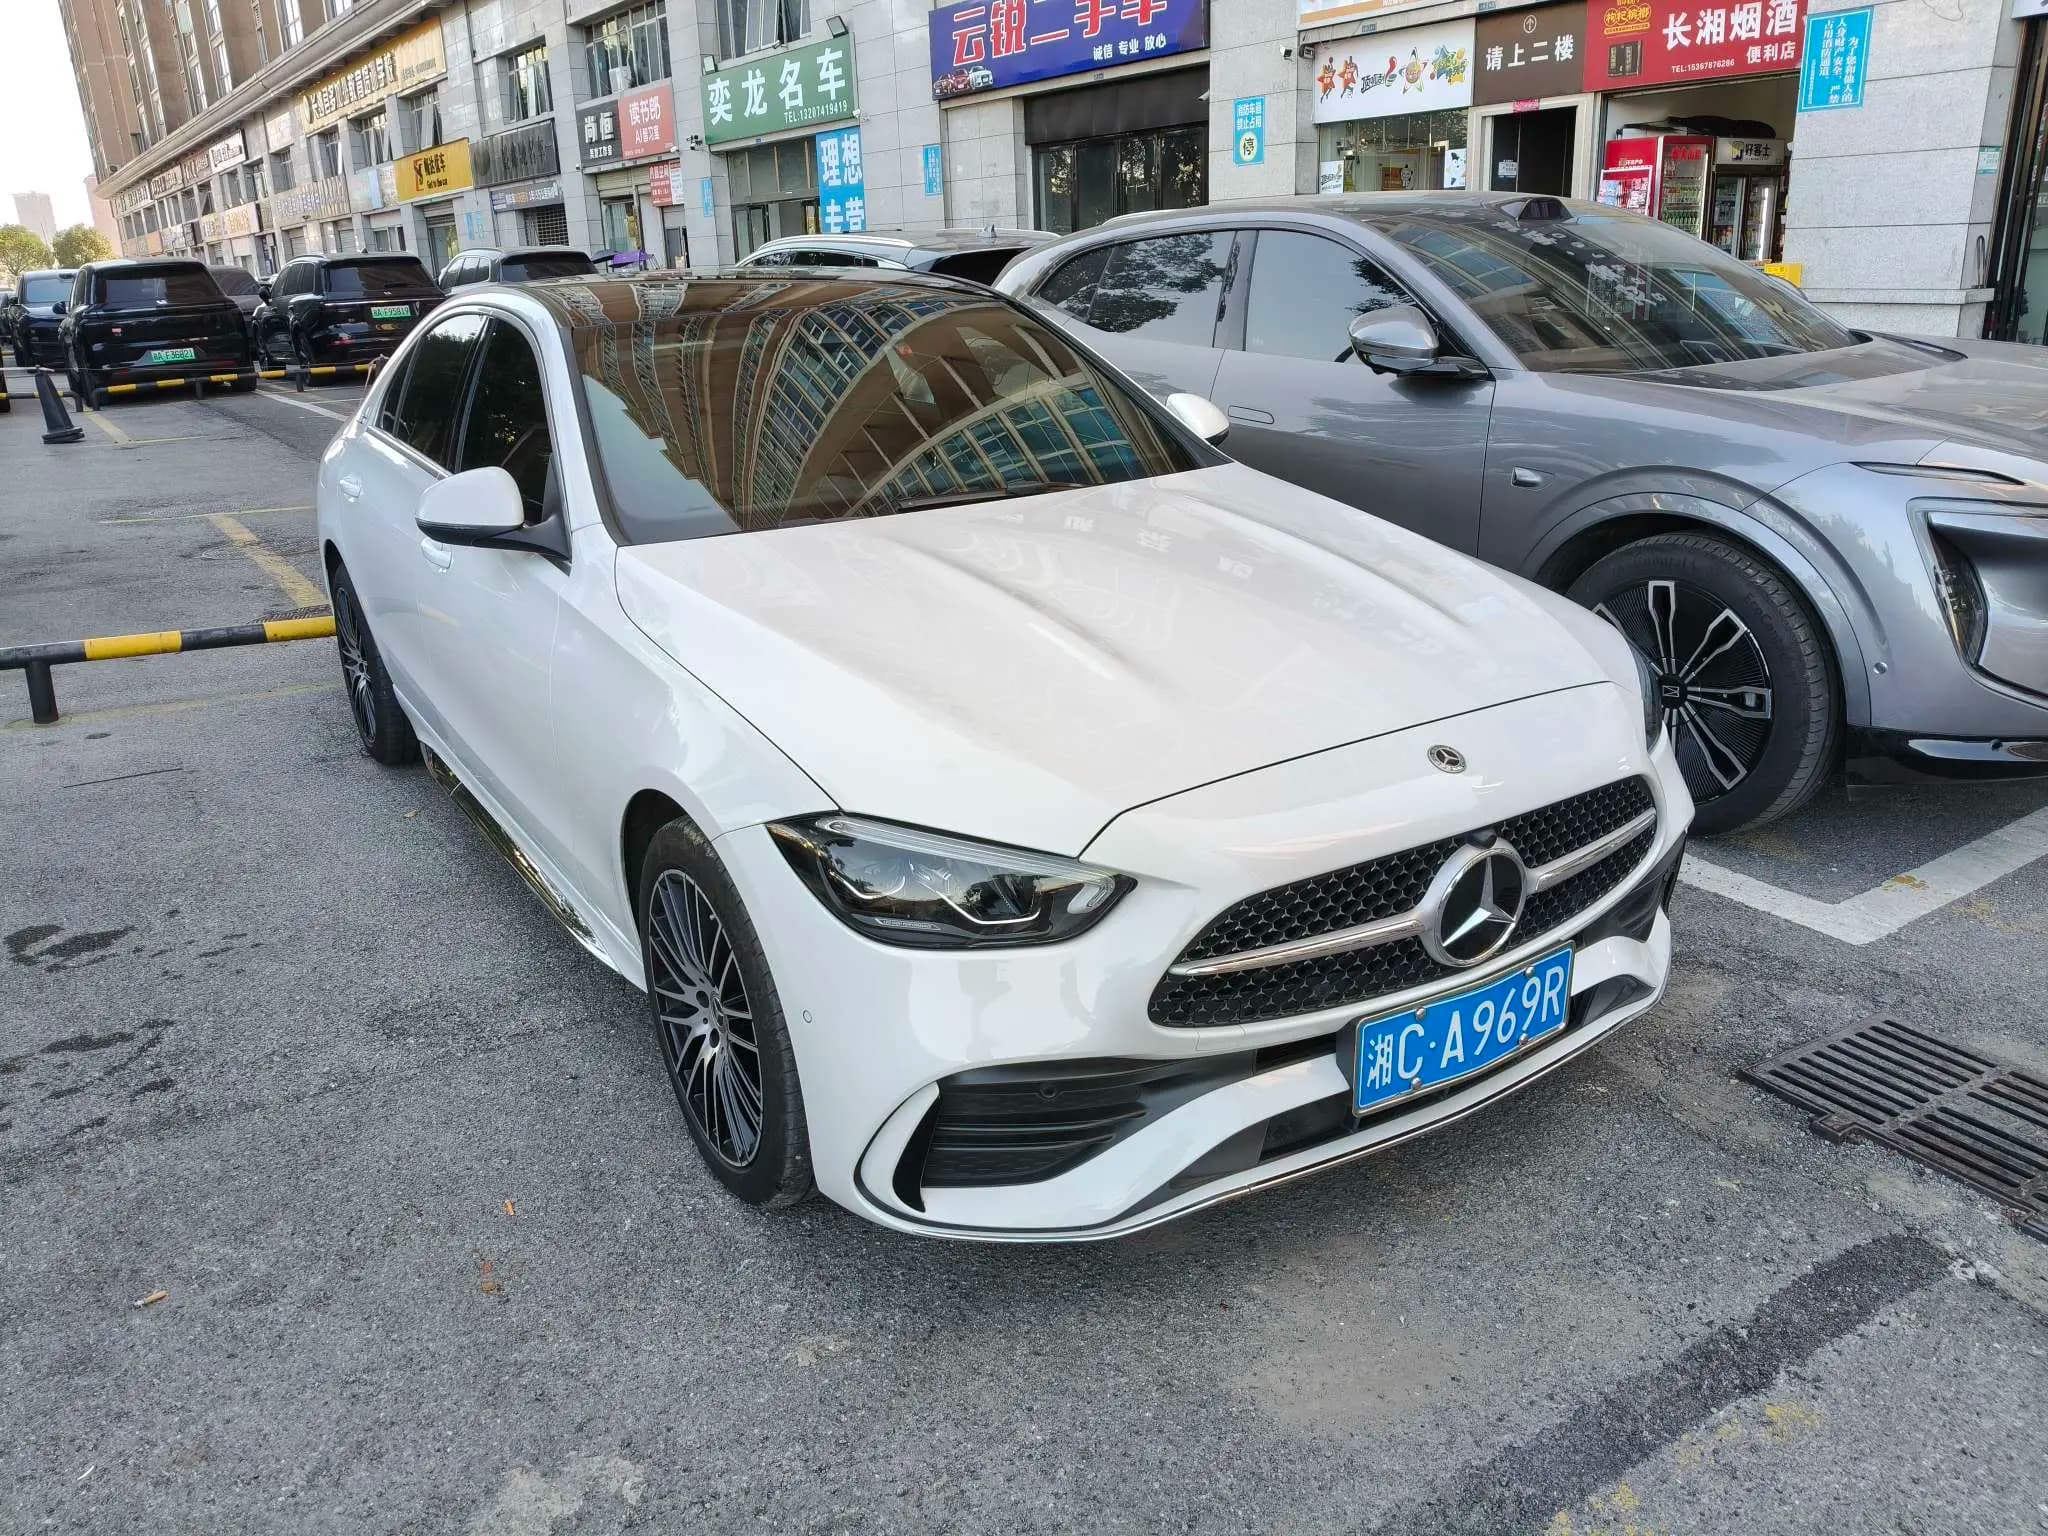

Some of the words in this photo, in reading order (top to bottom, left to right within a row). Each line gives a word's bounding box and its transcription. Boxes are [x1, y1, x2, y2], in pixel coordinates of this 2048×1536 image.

[1662, 0, 1798, 51] 长湘烟酒
[1093, 44, 1113, 61] 诚信
[1118, 38, 1139, 55] 专业
[1144, 33, 1166, 51] 放心
[1486, 34, 1573, 71] 请上二楼
[1746, 41, 1796, 64] 便利店
[707, 48, 845, 126] 奕龙名车
[584, 112, 614, 143] 尚恒
[629, 96, 661, 125] 读书郎
[820, 133, 863, 186] 理想
[1242, 137, 1255, 157] 停
[1366, 965, 1565, 1090] 湘C·A969R
